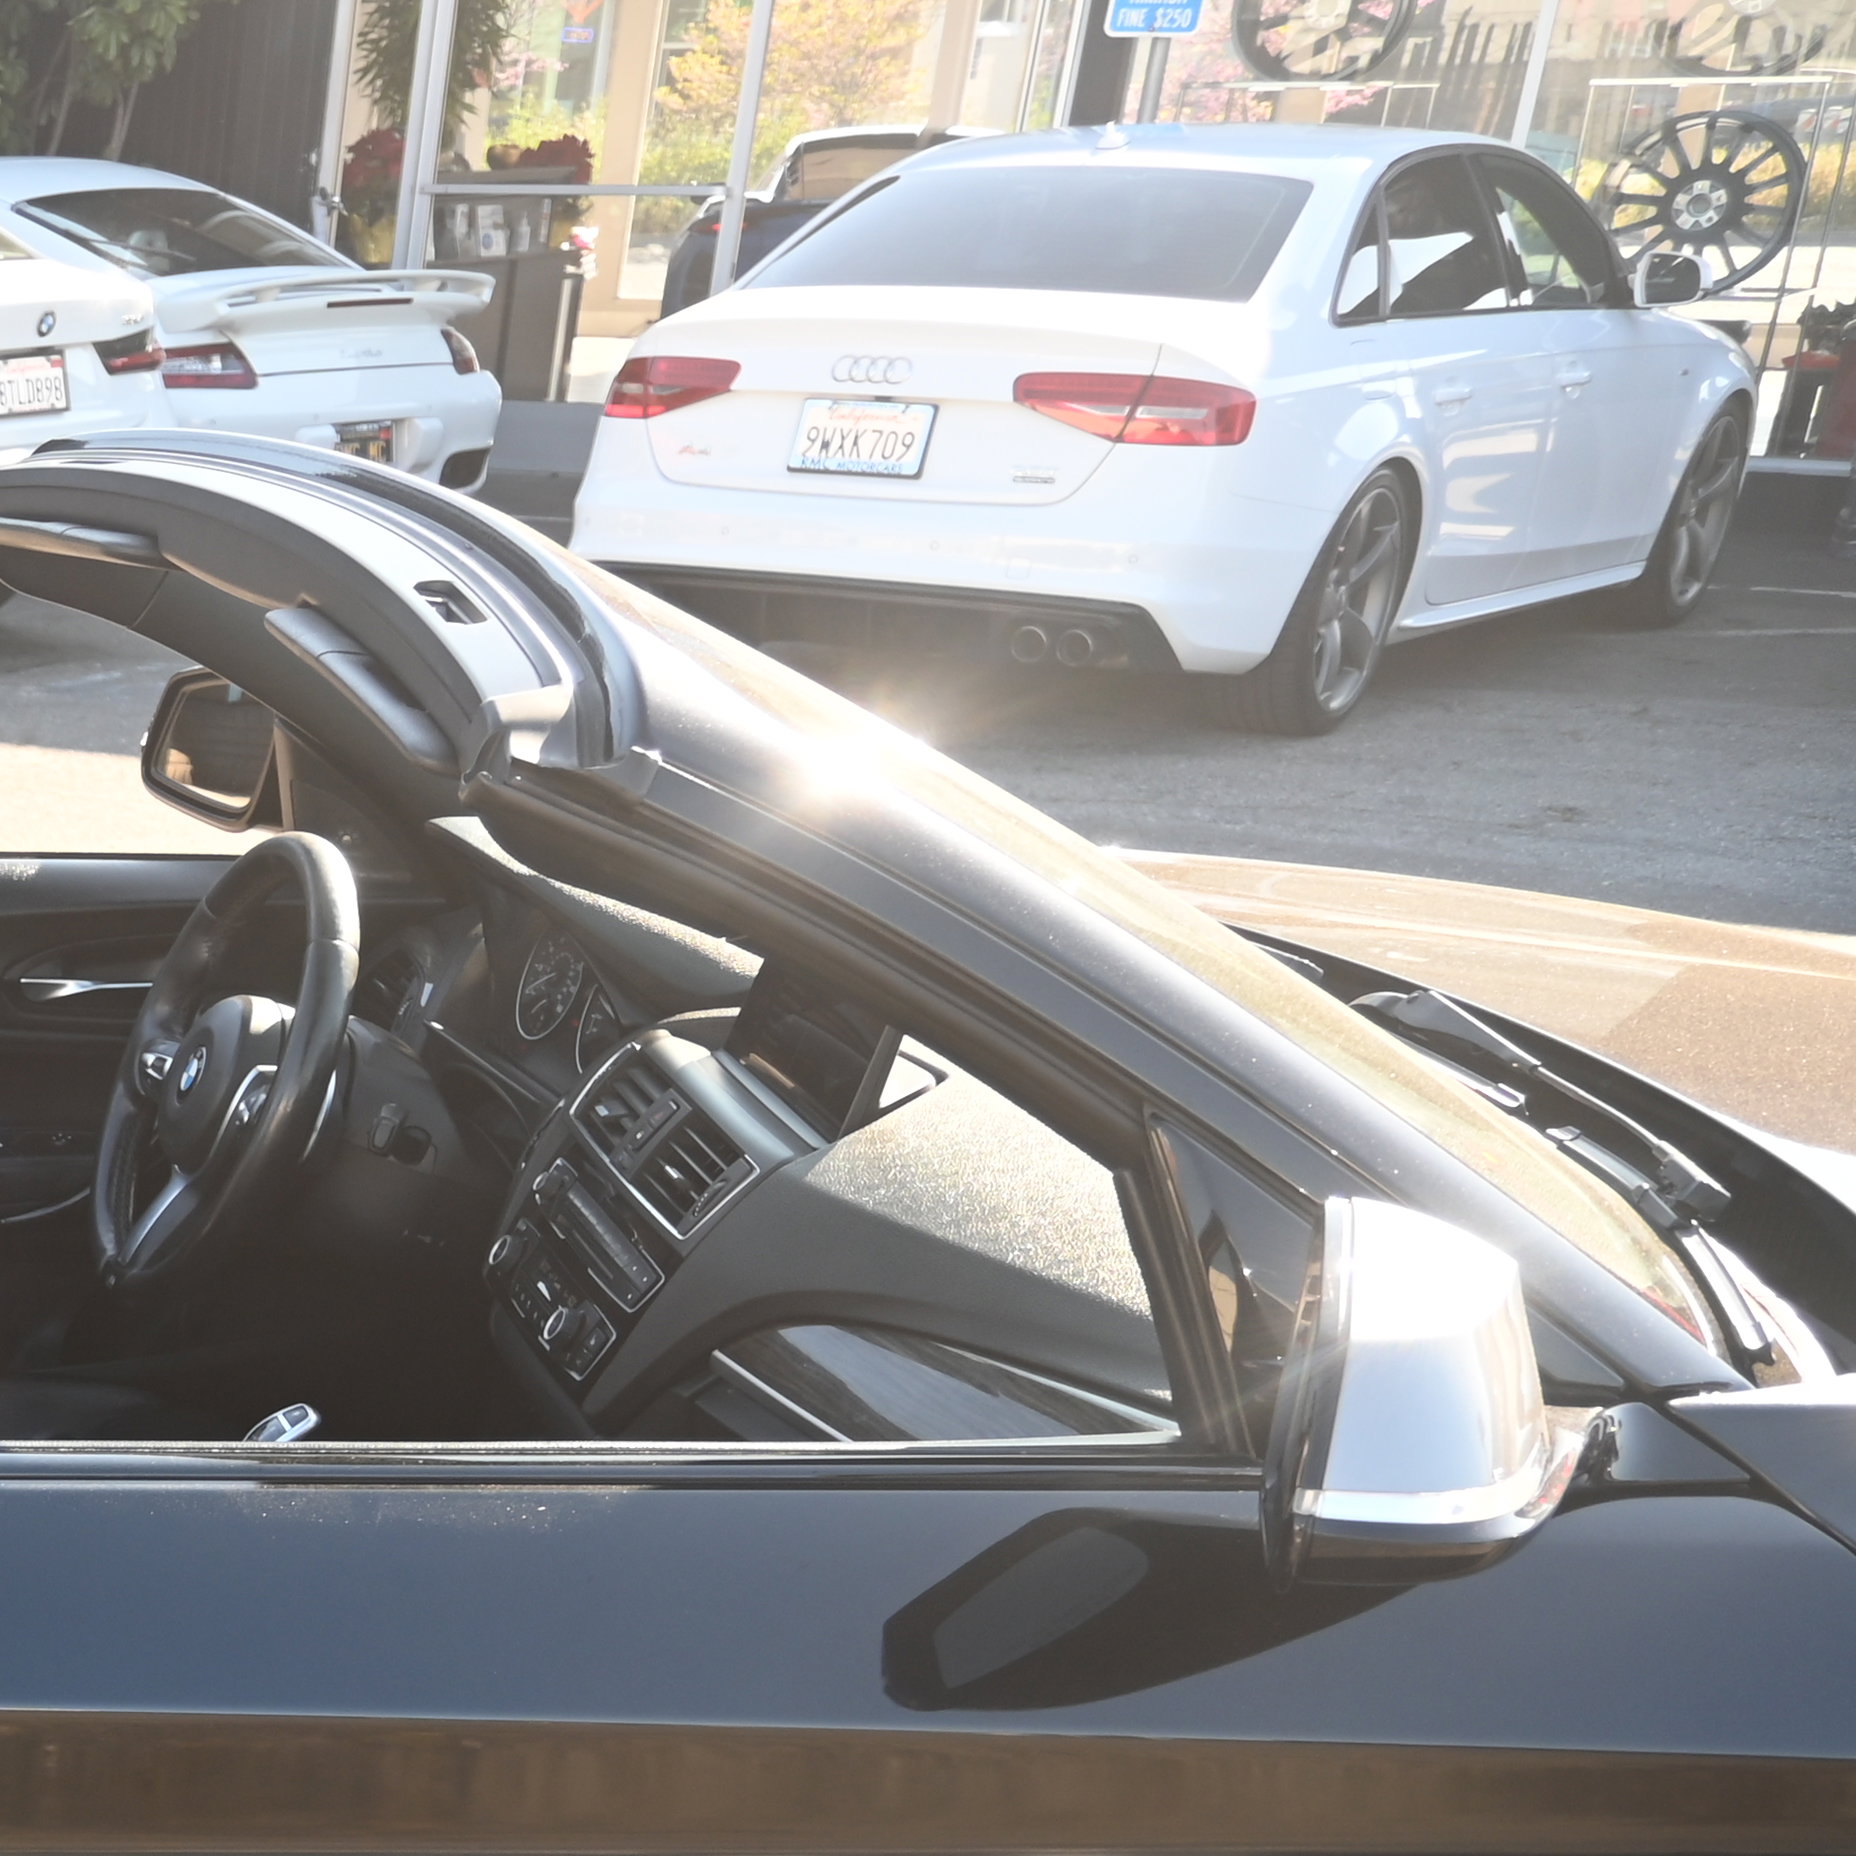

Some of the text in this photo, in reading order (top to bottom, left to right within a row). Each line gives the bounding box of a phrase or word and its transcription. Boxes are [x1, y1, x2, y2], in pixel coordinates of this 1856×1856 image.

[1116, 7, 1192, 28] FINE $250
[802, 426, 916, 462] 9WXK709
[800, 456, 903, 475] RMC MOTORCARS
